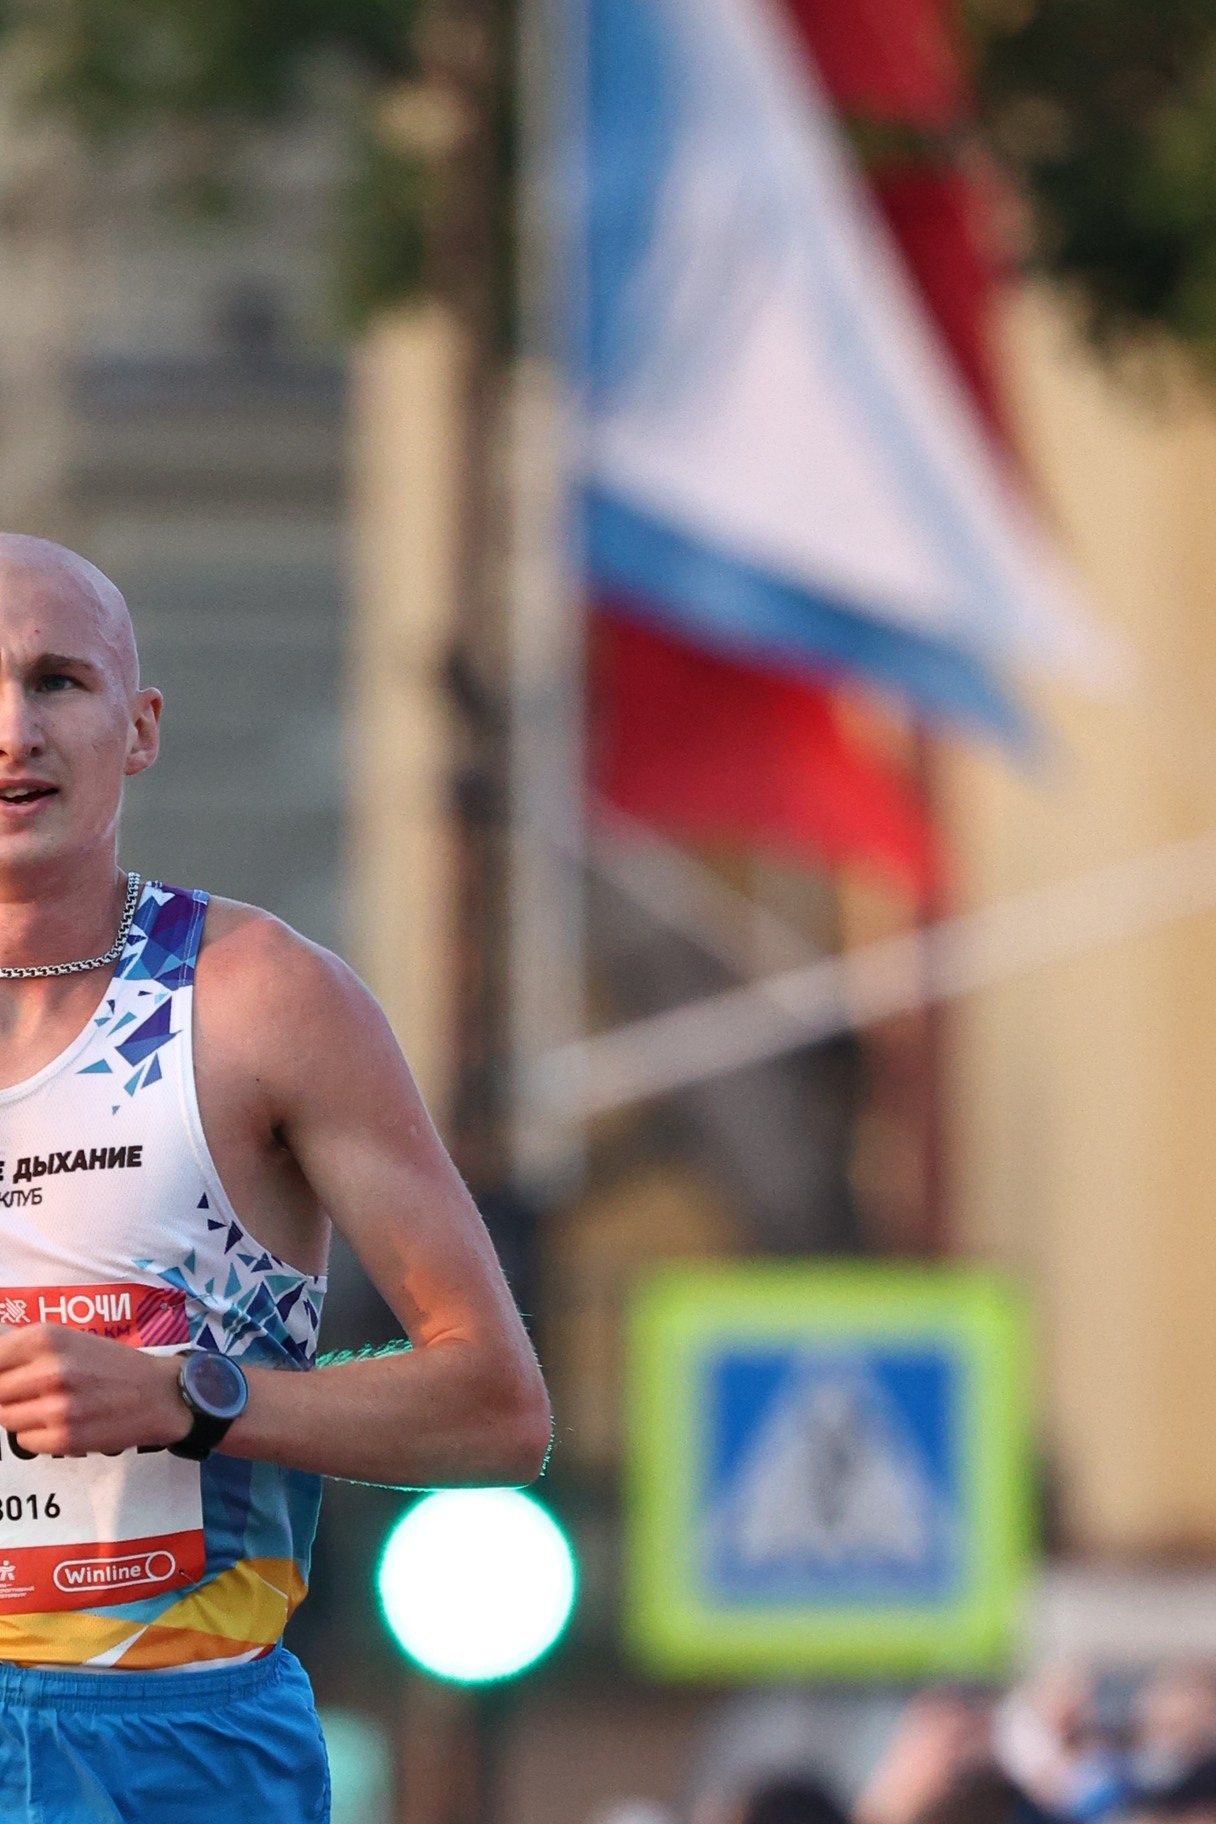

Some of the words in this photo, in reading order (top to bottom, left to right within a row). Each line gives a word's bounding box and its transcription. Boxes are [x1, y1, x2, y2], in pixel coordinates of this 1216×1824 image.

[12, 1145, 143, 1184] ДЫХАНИЕ
[38, 1292, 132, 1325] НОЧИ
[64, 1564, 142, 1584] Winline
